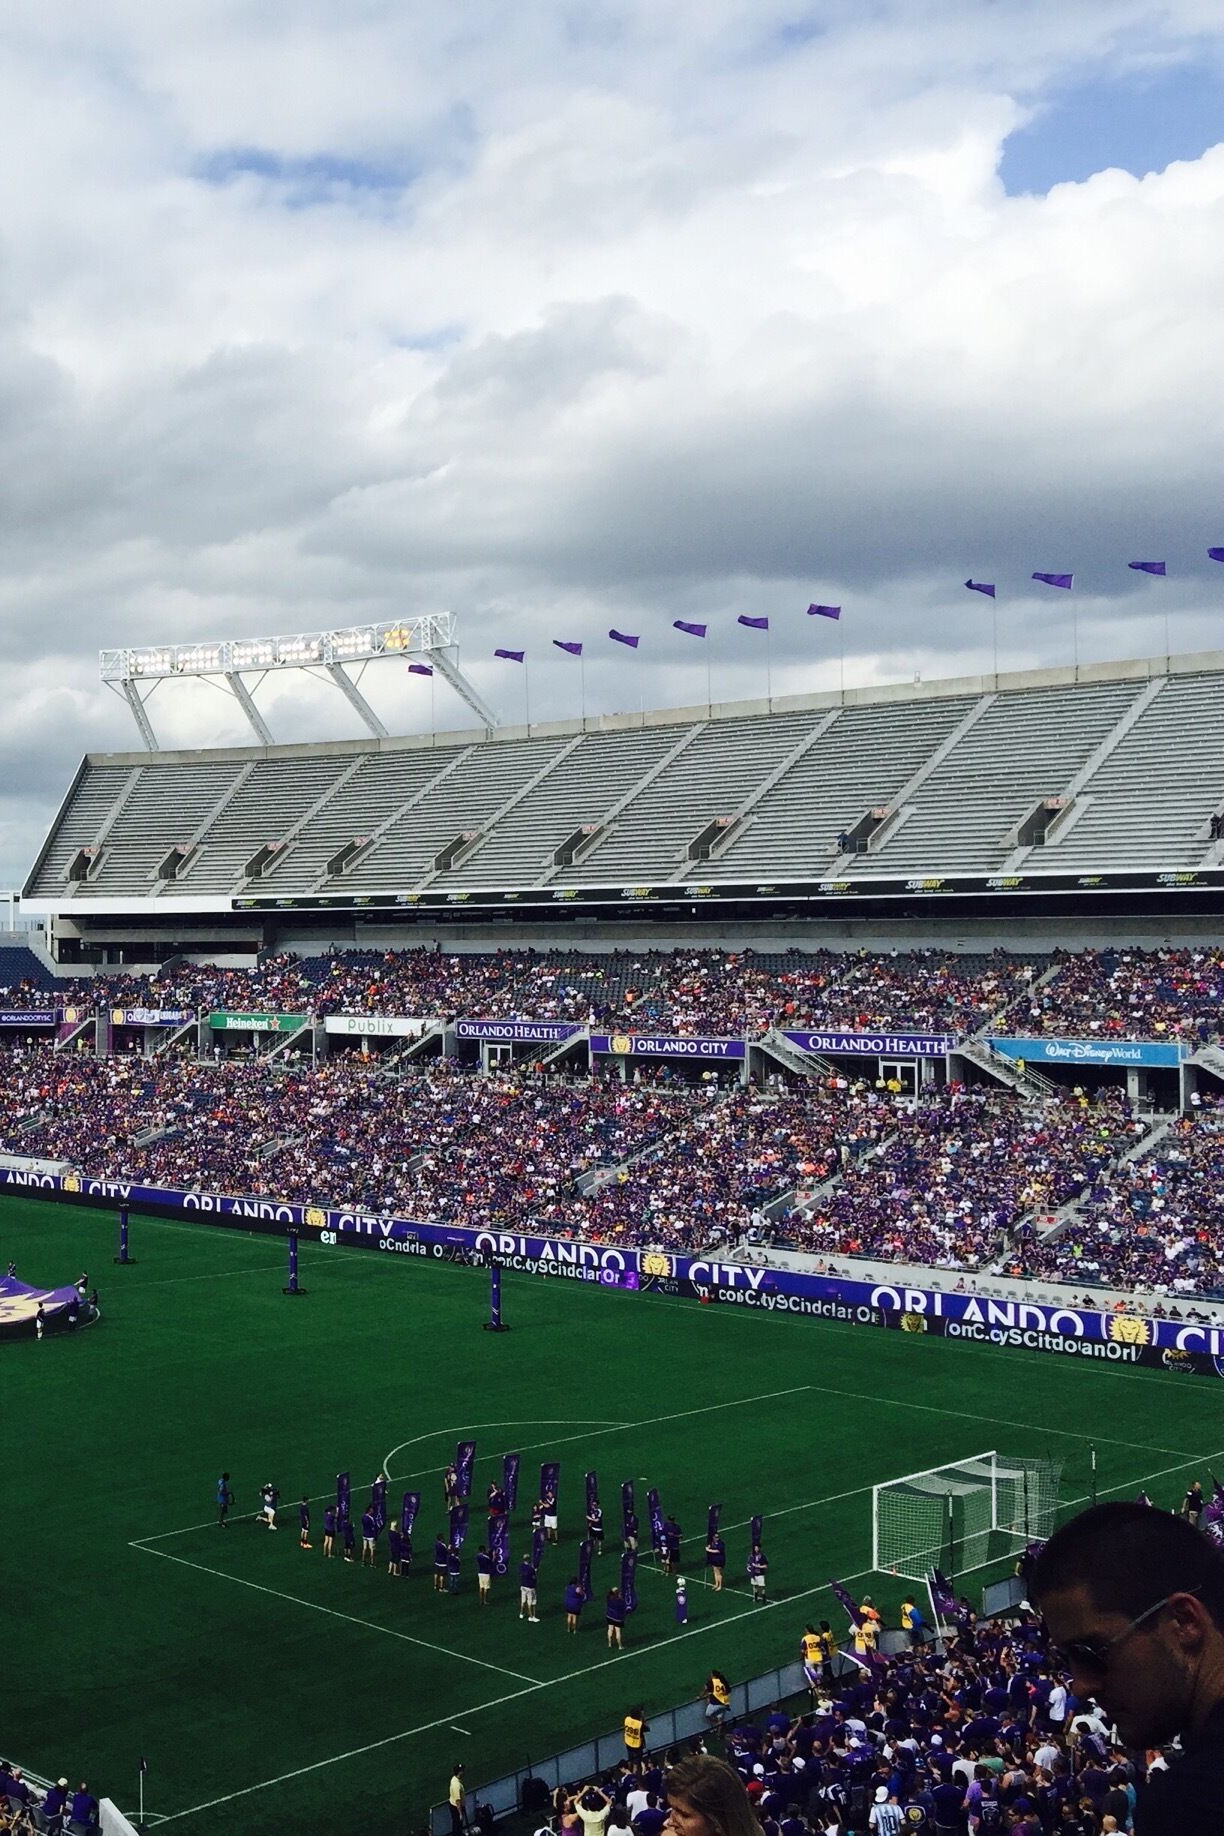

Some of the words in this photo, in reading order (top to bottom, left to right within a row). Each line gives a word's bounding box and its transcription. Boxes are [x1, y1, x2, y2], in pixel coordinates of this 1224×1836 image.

[905, 879, 945, 889] SUBWAY
[986, 878, 1023, 887] SUBWAY
[1157, 873, 1198, 883] SUBWAY
[226, 1016, 269, 1030] Heineken
[347, 1018, 395, 1034] Publix
[459, 1022, 513, 1037] ORLANDO
[513, 1025, 559, 1040] HEALTH
[637, 1040, 698, 1054] ORLANDO
[700, 1042, 728, 1055] CITY
[808, 1035, 883, 1052] ORLANDO
[884, 1037, 946, 1055] HEALTH
[688, 1261, 766, 1290] CITY
